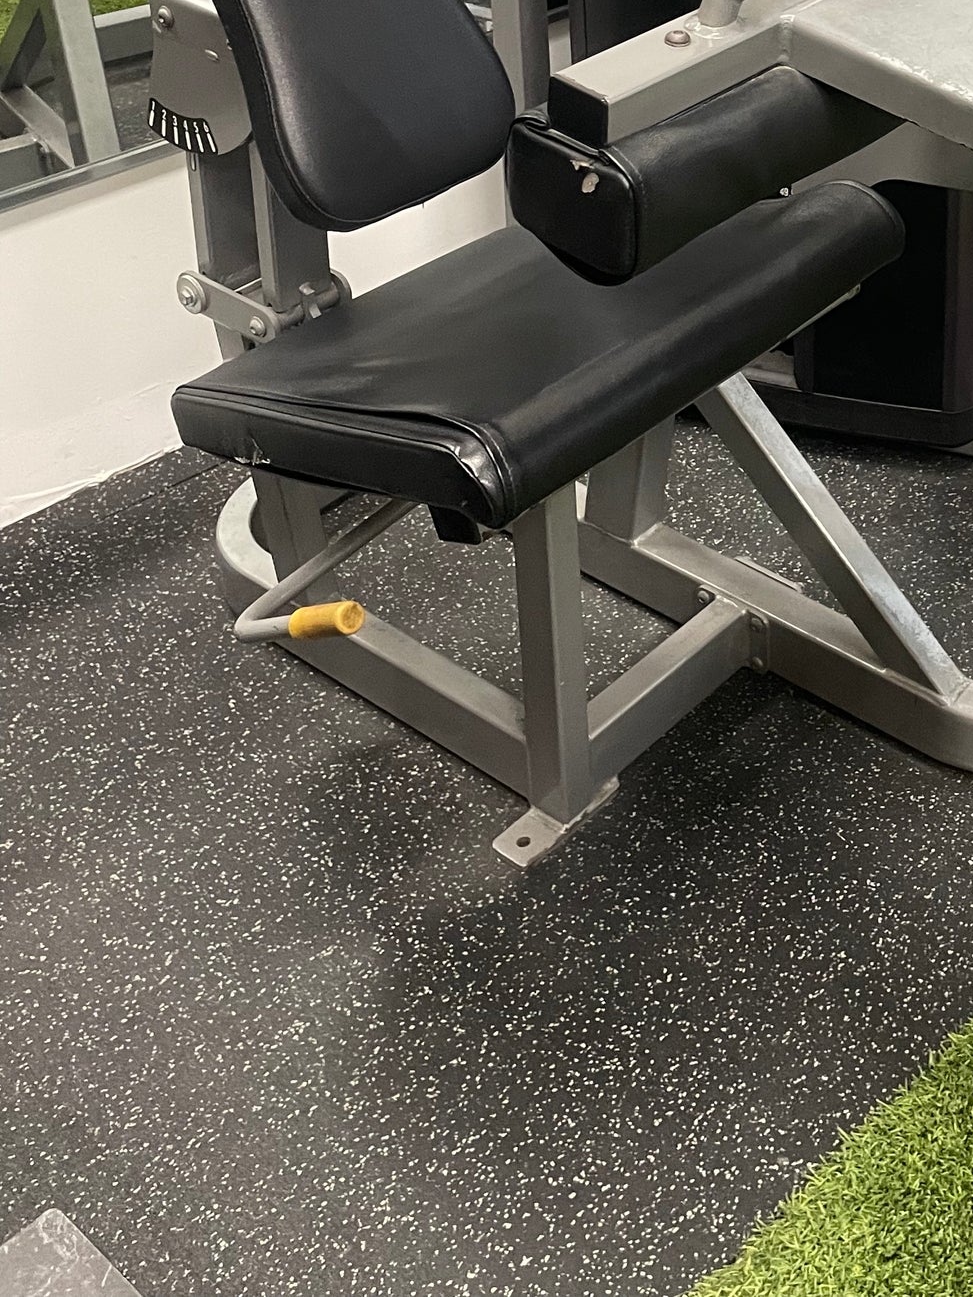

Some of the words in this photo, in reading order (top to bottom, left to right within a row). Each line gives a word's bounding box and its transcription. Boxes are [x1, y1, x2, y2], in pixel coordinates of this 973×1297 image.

[152, 101, 155, 110] 1
[162, 109, 166, 120] 2
[173, 115, 177, 126] 3
[183, 120, 188, 130] 4
[193, 122, 199, 133] 5
[203, 122, 209, 132] 6
